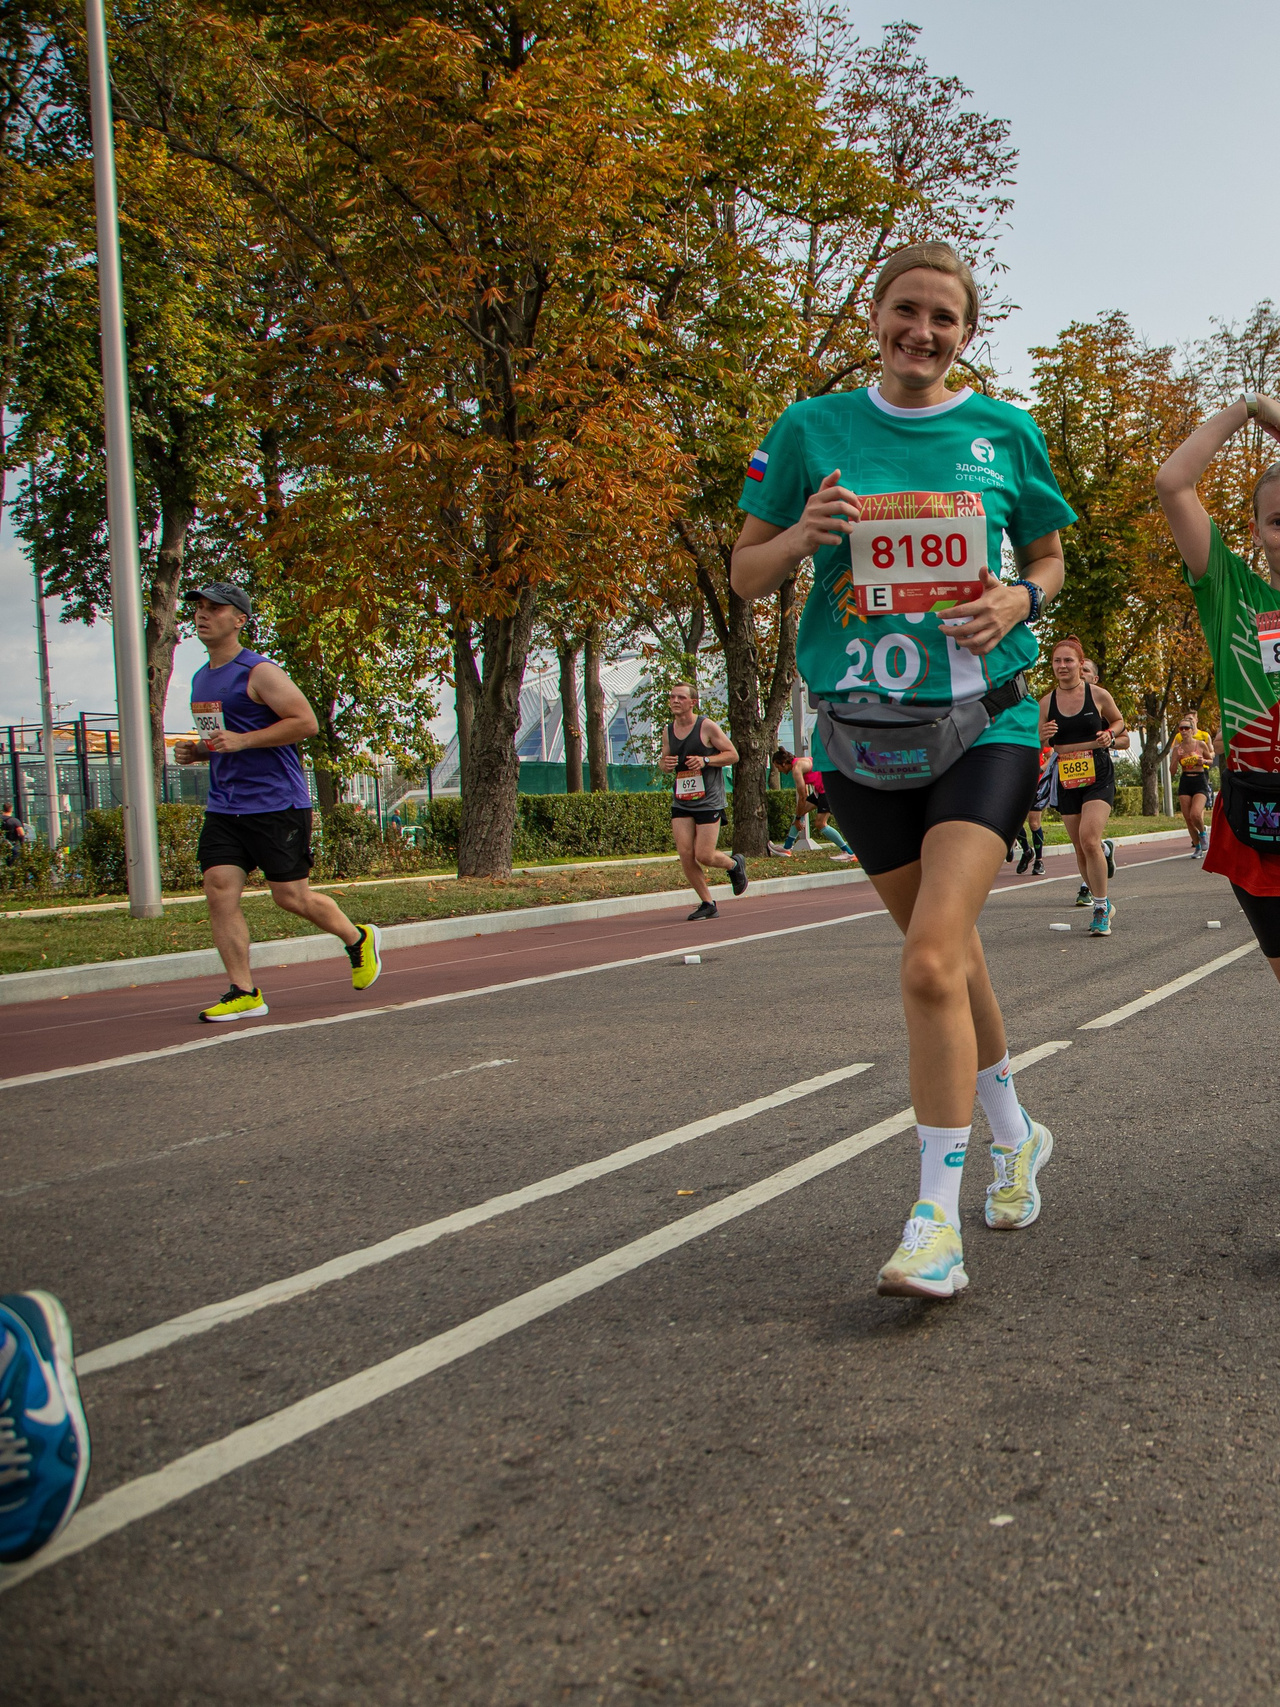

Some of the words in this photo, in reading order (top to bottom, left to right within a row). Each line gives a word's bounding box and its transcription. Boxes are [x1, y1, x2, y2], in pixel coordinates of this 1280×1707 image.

[955, 463, 1005, 482] ЗДОРОВОЕ
[955, 473, 1005, 489] ОТЕЧЕСТВО
[956, 494, 978, 506] 21,1
[871, 533, 968, 569] 8180
[873, 587, 887, 607] E
[197, 716, 221, 730] 3854
[896, 765, 918, 773] POLE
[1062, 761, 1089, 775] 5683
[682, 778, 697, 789] 692
[876, 773, 902, 781] EVENT
